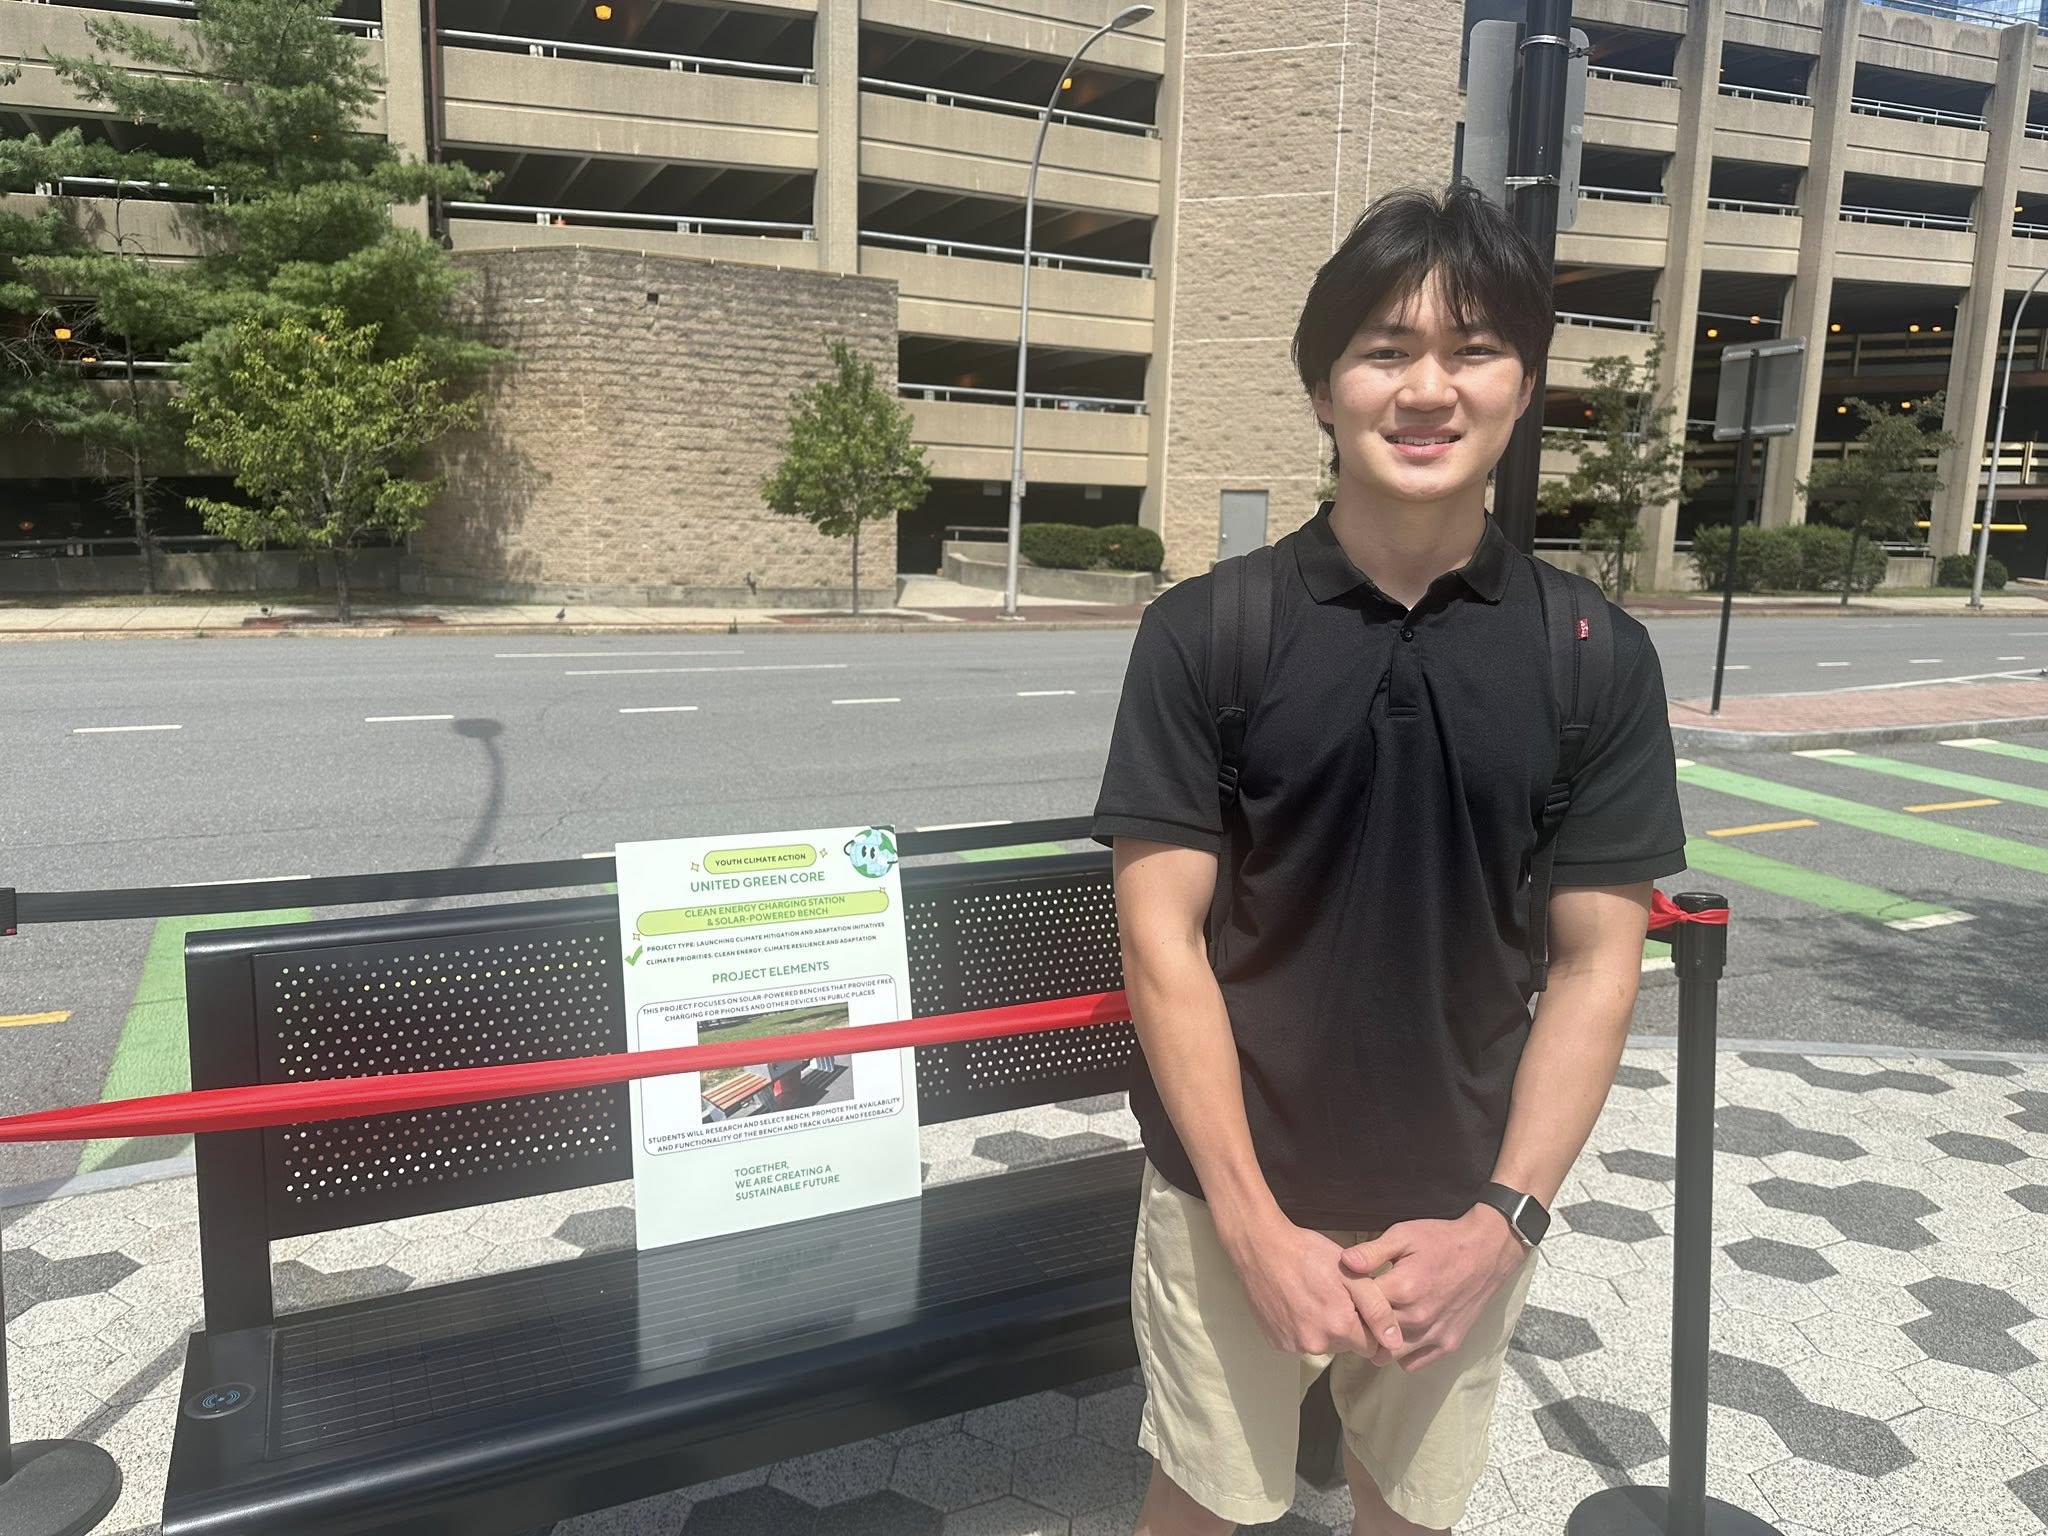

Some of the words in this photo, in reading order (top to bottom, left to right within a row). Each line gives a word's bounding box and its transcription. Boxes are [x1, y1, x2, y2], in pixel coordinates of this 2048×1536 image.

[715, 858, 742, 866] YOUTH
[743, 856, 775, 864] CLIMATE
[776, 853, 806, 862] ACTION
[690, 878, 740, 892] UNITED
[743, 875, 787, 888] GREEN
[790, 871, 825, 884] CORE
[684, 906, 716, 918] CLEAN
[718, 903, 757, 915] ENERGY
[758, 899, 807, 912] CHARGING
[808, 896, 845, 907] STATION
[707, 918, 713, 926] &
[714, 910, 796, 926] SOLAR-POWERED
[797, 907, 829, 919] BENCH
[646, 944, 677, 952] PROJECT
[696, 938, 735, 946] LAUNCHING
[735, 935, 762, 943] CLIMATE
[763, 931, 799, 939] MITIGATION
[814, 926, 851, 934] ADAPTATION
[852, 922, 885, 930] INITIATIVES
[646, 957, 675, 965] CLIMATE
[764, 945, 790, 953] CLIMATE
[791, 941, 826, 949] RESILIENCE
[839, 936, 877, 944] ADAPTATION
[712, 968, 767, 983] PROJECT
[769, 961, 830, 977] ELEMENTS
[660, 1003, 692, 1012] PROJECT
[693, 999, 726, 1008] FOCUSES
[738, 990, 798, 1002] SOLAR-POWERED
[799, 986, 830, 994] BENCHES
[831, 984, 847, 992] THAT
[847, 980, 876, 988] PROVIDE
[877, 977, 893, 985] FREE
[664, 1012, 704, 1022] CHARGING
[720, 1006, 749, 1014] PHONES
[766, 1001, 789, 1009] OTHER
[790, 997, 818, 1005] DEVICES
[827, 992, 850, 1001] PUBLIC
[851, 990, 876, 998] PLACES
[648, 1132, 686, 1144] STUDENTS
[686, 1129, 704, 1137] WILL
[705, 1123, 743, 1134] RESEARCH
[743, 1121, 759, 1129] AND
[760, 1116, 784, 1125] SELECT
[786, 1112, 810, 1121] BENCH,
[811, 1107, 845, 1117] PROMOTE
[845, 1104, 858, 1112] THE
[858, 1098, 900, 1109] AVAILABILITY
[657, 1144, 673, 1152] AND
[674, 1135, 731, 1149] FUNCTIONALITY
[732, 1133, 743, 1141] OF
[744, 1130, 758, 1139] THE
[758, 1126, 783, 1136] BENCH
[783, 1124, 799, 1132] AND
[799, 1120, 821, 1129] TRACK
[822, 1116, 844, 1125] USAGE
[845, 1114, 859, 1122] AND
[860, 1108, 894, 1119] FEEDBACK
[734, 1161, 790, 1177] TOGETHER,
[735, 1179, 752, 1189] WE
[753, 1175, 773, 1186] ARE
[775, 1166, 823, 1181] CREATING
[824, 1165, 832, 1173] A
[735, 1182, 801, 1201] SUSTAINABLE
[802, 1175, 840, 1188] FUTURE
